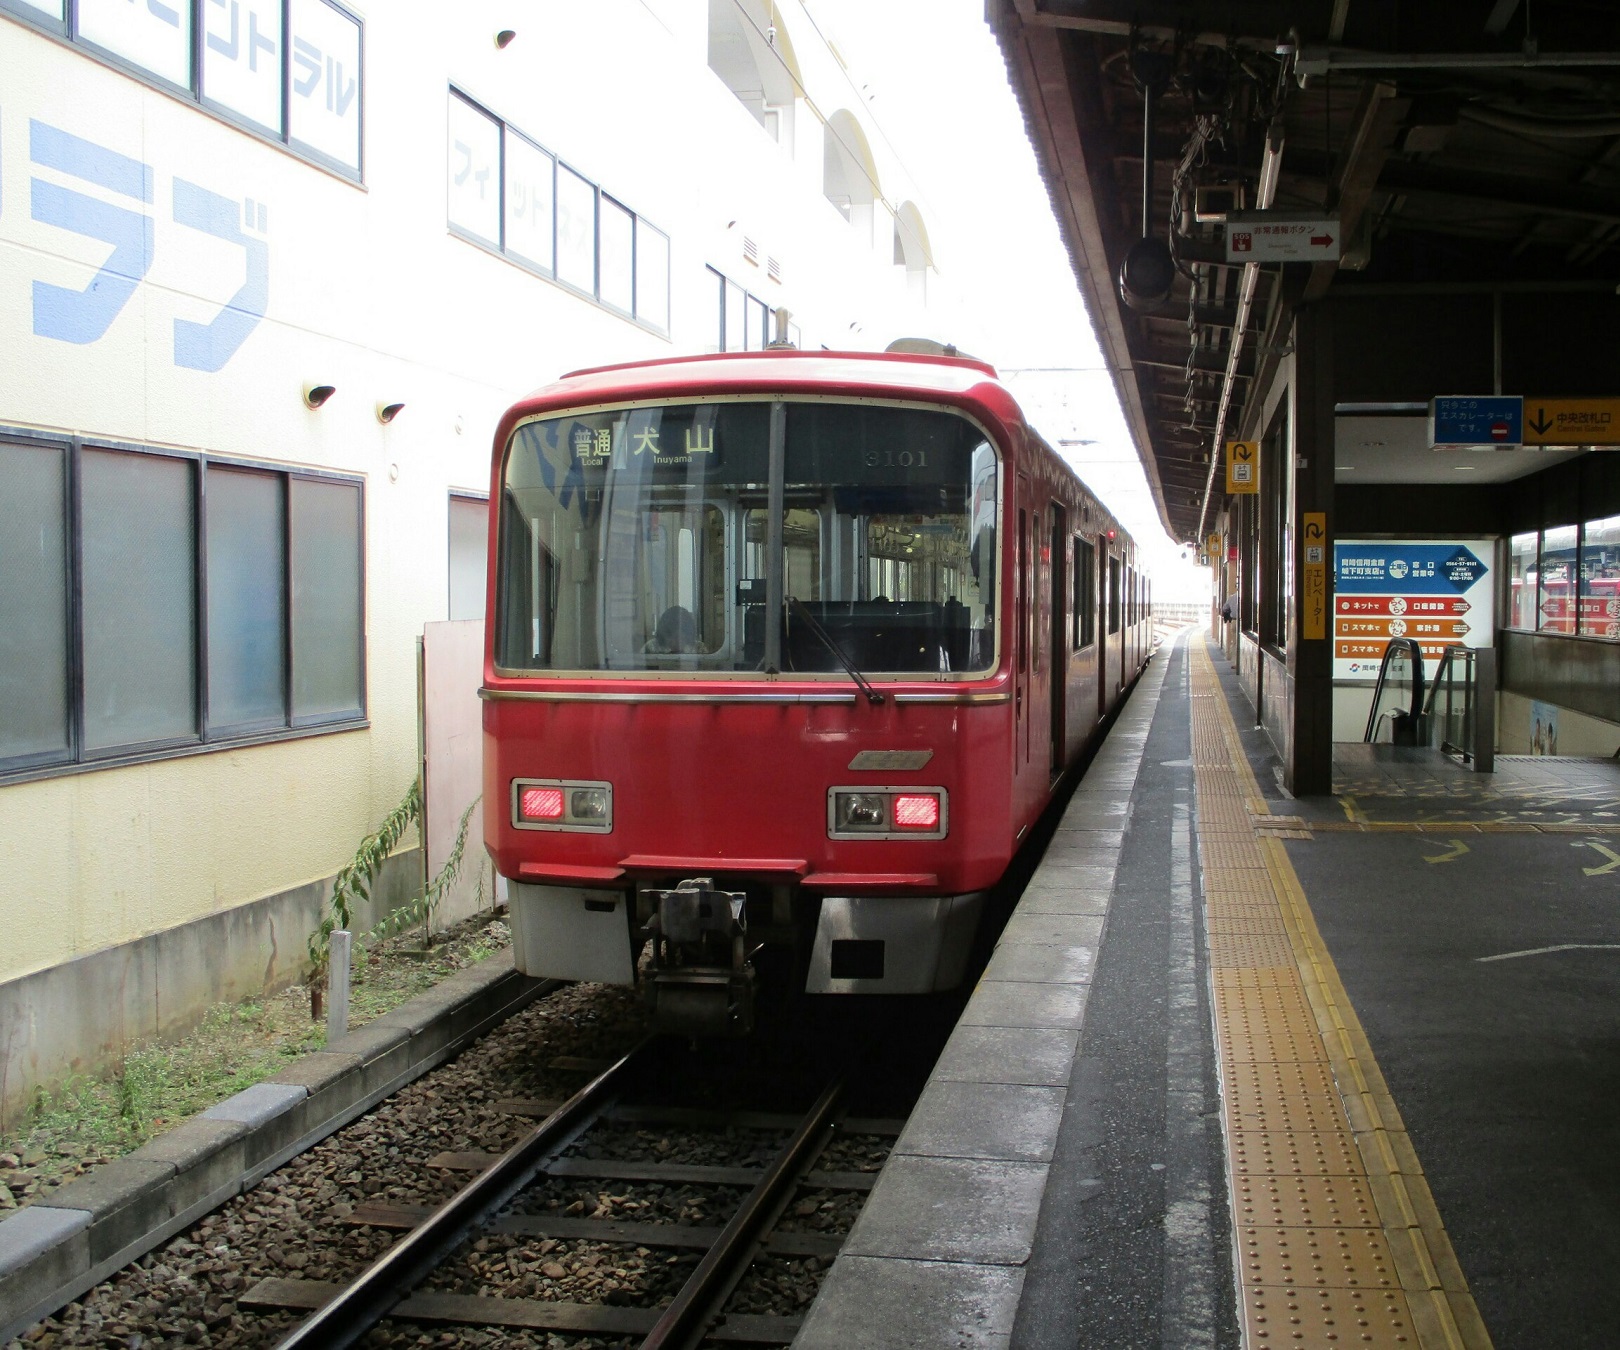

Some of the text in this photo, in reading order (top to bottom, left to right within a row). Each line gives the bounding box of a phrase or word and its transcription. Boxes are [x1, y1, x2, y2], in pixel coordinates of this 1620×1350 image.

[127, 0, 356, 118] ントラル
[1253, 225, 1316, 235] 非常通報ボタン
[0, 107, 269, 374] ラブ
[1440, 401, 1478, 409] 只今この
[1440, 410, 1513, 420] エスカレーターは
[1556, 412, 1611, 424] 中央改札口
[574, 428, 611, 457] 普通
[582, 457, 603, 466] Local
[653, 455, 693, 465] Inuyama
[1313, 569, 1322, 626] エレベーター
[1353, 602, 1380, 610] ネットで
[1351, 623, 1381, 631] スマホで
[1351, 645, 1380, 653] スマホで
